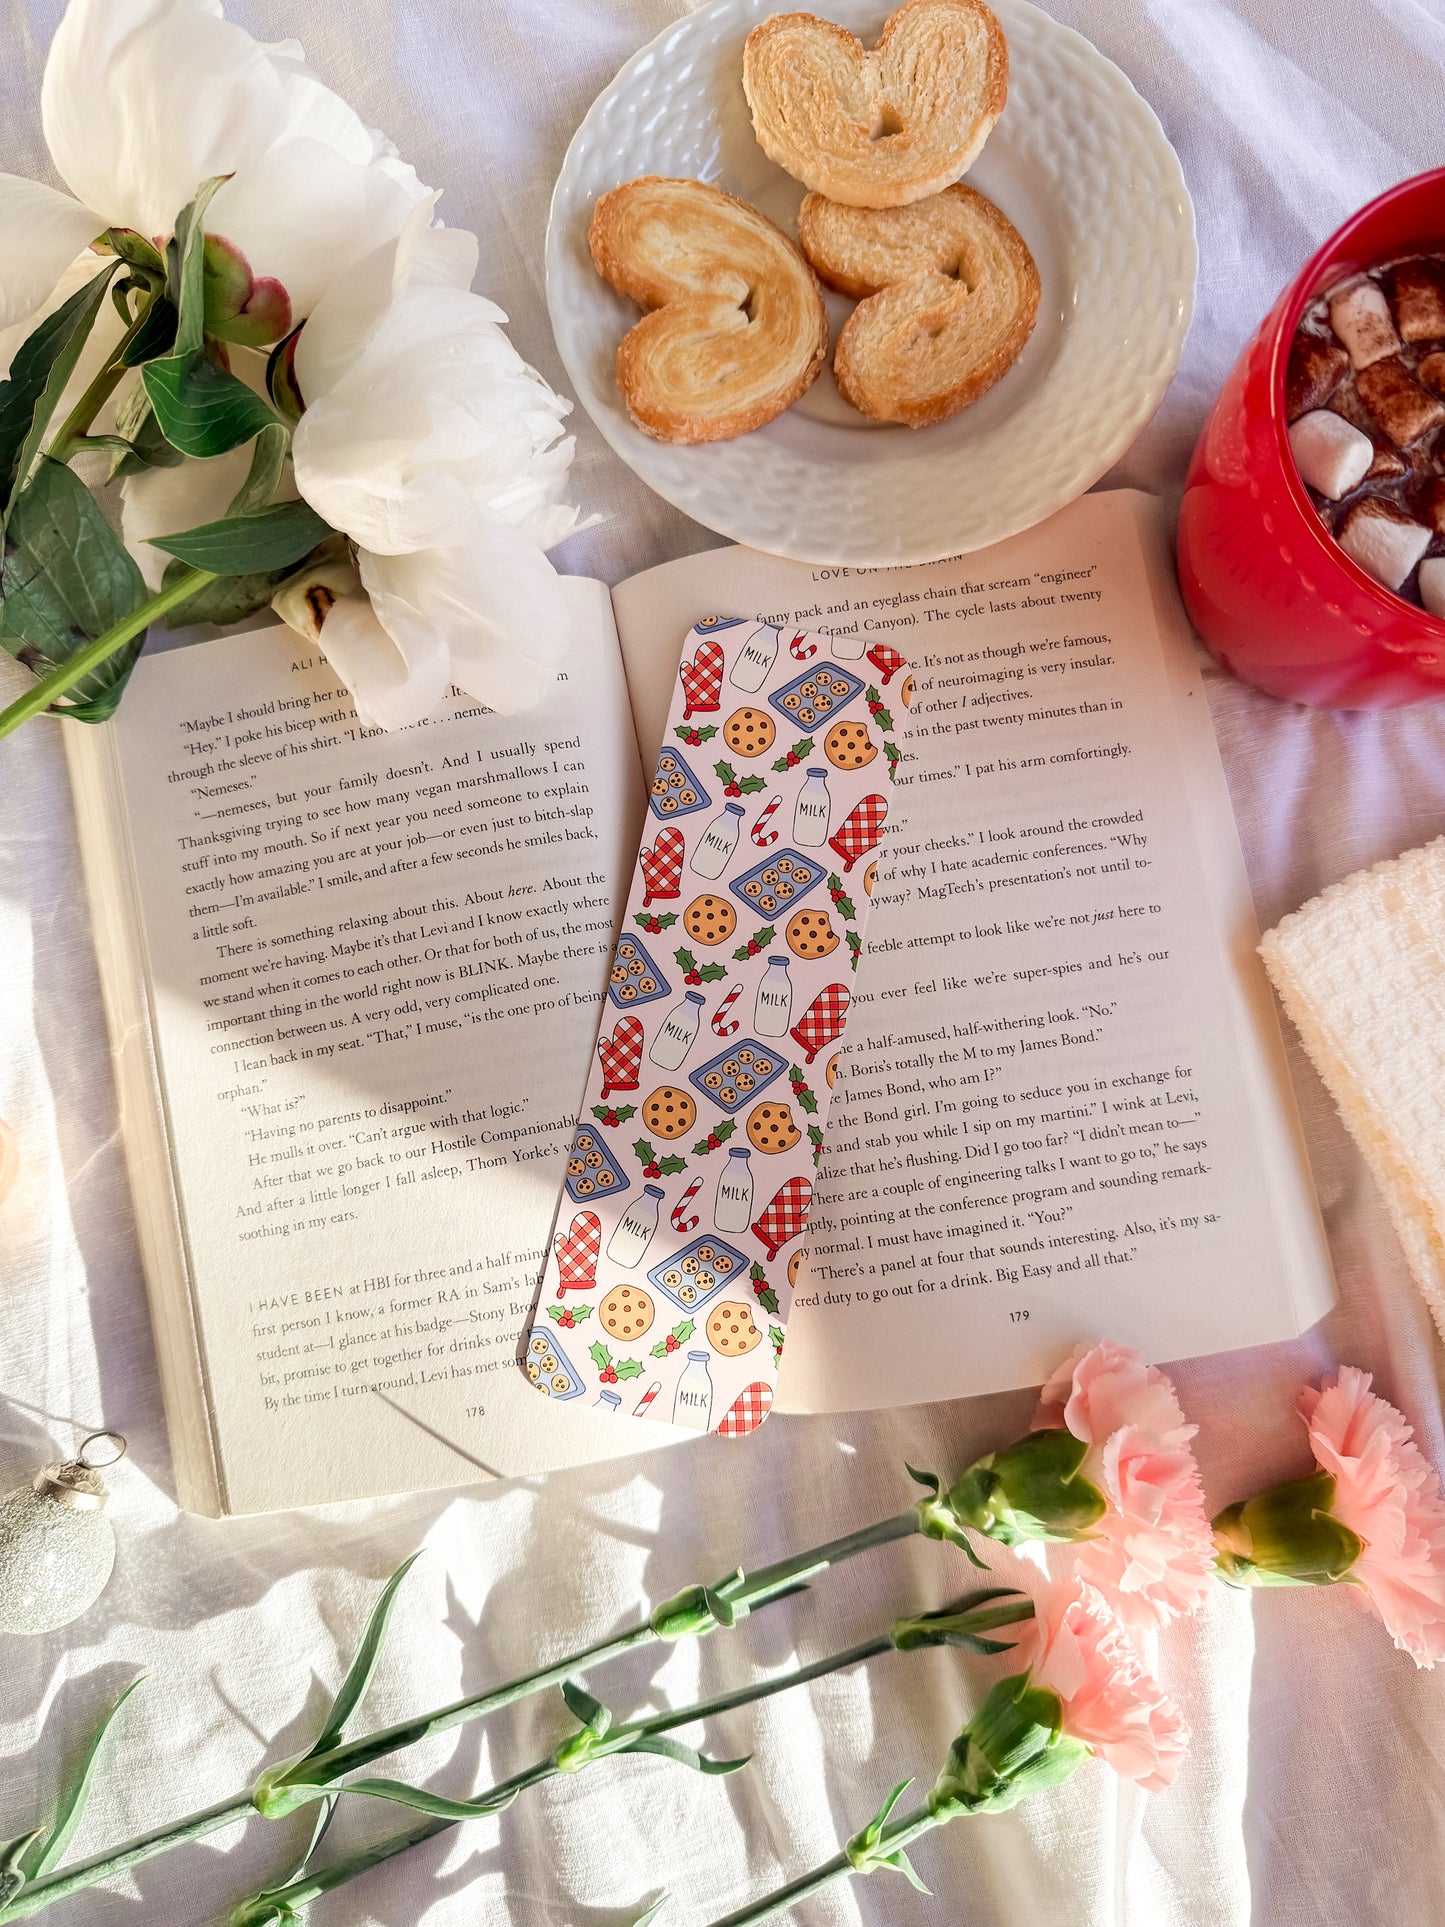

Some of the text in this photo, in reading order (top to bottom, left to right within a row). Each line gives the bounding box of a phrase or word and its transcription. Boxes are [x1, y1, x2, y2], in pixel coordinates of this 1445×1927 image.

[812, 567, 850, 581] LOVE
[756, 565, 1097, 624] fanny pack and an eyeglass chain that scream “engineer”
[818, 591, 1101, 636] Grand Canyon). The cycle lasts about twenty
[291, 658, 313, 672] ALI
[744, 646, 772, 668] MILK
[926, 699, 958, 712] other
[962, 696, 966, 707] I
[971, 690, 1033, 707] adjectives.
[191, 775, 256, 799] “Nemeses.”
[194, 736, 581, 819] “—nemeses, but your family doesn’t. And I usually spend
[178, 761, 585, 850] Thanksgiving trying to see how many vegan marshmallows I can
[800, 803, 827, 818] MILK
[186, 804, 593, 895] exactly how amazing you are at your job—or even just to bitch-slap
[704, 832, 733, 855] MILK
[216, 872, 605, 958] There is something relaxing about this. About here. About the
[200, 896, 609, 986] moment we’re having. Maybe it’s that Levi and I know exactly where
[867, 938, 903, 954] feeble
[907, 933, 955, 948] attempt
[959, 931, 972, 940] to
[974, 923, 1002, 938] look
[1006, 920, 1030, 933] like
[1034, 915, 1066, 929] we’re
[1070, 914, 1090, 925] not
[1092, 910, 1114, 926] just
[1118, 906, 1145, 918] here
[1149, 905, 1161, 913] to
[851, 951, 1169, 1008] you ever feel like we’re super-spies and he’s our
[761, 992, 787, 1007] MILK
[210, 977, 559, 1054] connection between us. A very odd, very complicated one.
[665, 1022, 692, 1044] MILK
[299, 1122, 314, 1132] no
[318, 1112, 361, 1132] parents
[364, 1109, 376, 1118] to
[722, 1185, 750, 1202] MILK
[239, 1212, 358, 1241] soothing in my ears.
[622, 1216, 651, 1240] MILK
[811, 1214, 1221, 1279] “There’s a panel at four that sounds interesting. Also, it’s my sa-
[795, 1247, 1137, 1307] cred duty to go out for a drink. Big Easy and all that.”
[1009, 1310, 1029, 1322] 179
[466, 1406, 485, 1418] 178
[679, 1392, 708, 1408] MILK
